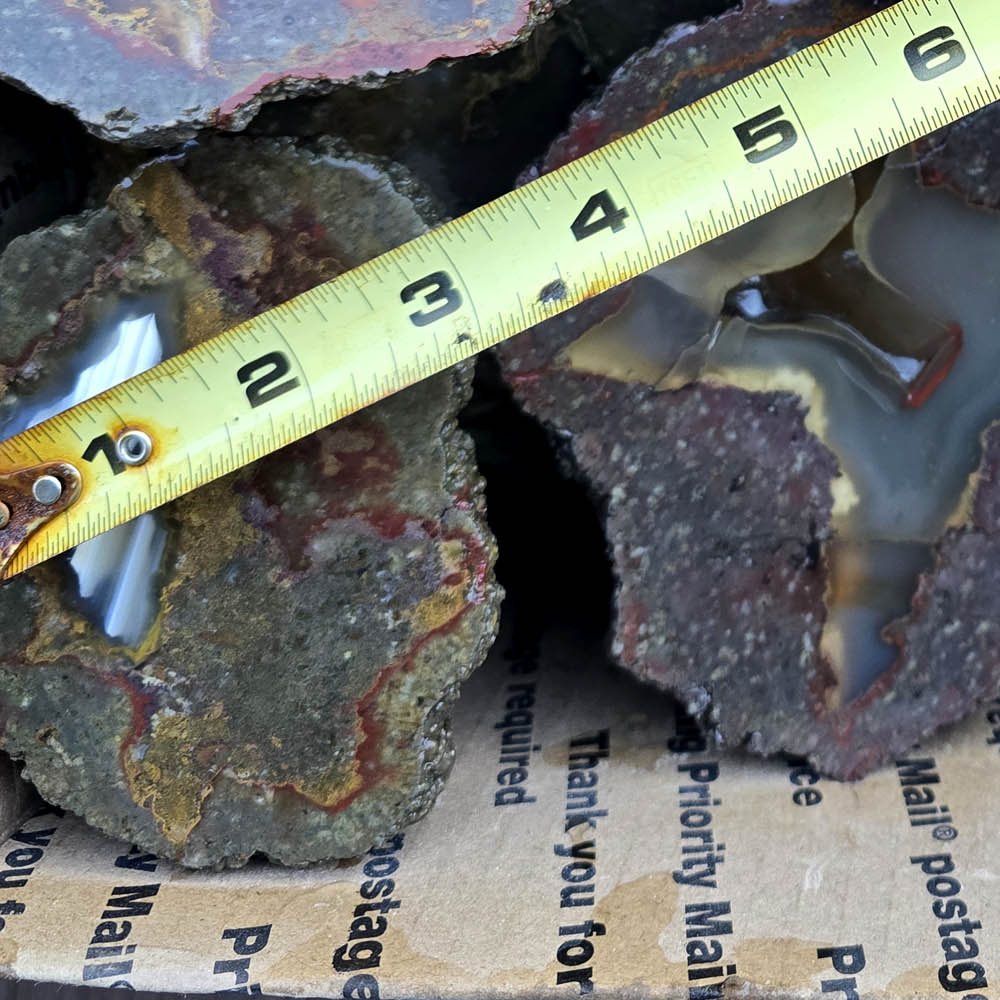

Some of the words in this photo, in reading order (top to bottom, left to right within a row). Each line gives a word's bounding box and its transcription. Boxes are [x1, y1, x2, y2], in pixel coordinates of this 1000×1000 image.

[82, 432, 128, 475] 1
[237, 351, 299, 408] 2
[400, 271, 463, 327] 3
[570, 189, 629, 242] 4
[732, 105, 798, 164] 5
[903, 25, 967, 82] 6
[494, 683, 542, 807] required
[564, 728, 610, 831] Thank
[554, 840, 597, 908] you
[672, 761, 726, 888] Priority
[83, 883, 161, 991] Mail
[556, 920, 606, 995] for
[910, 853, 989, 1000] postag
